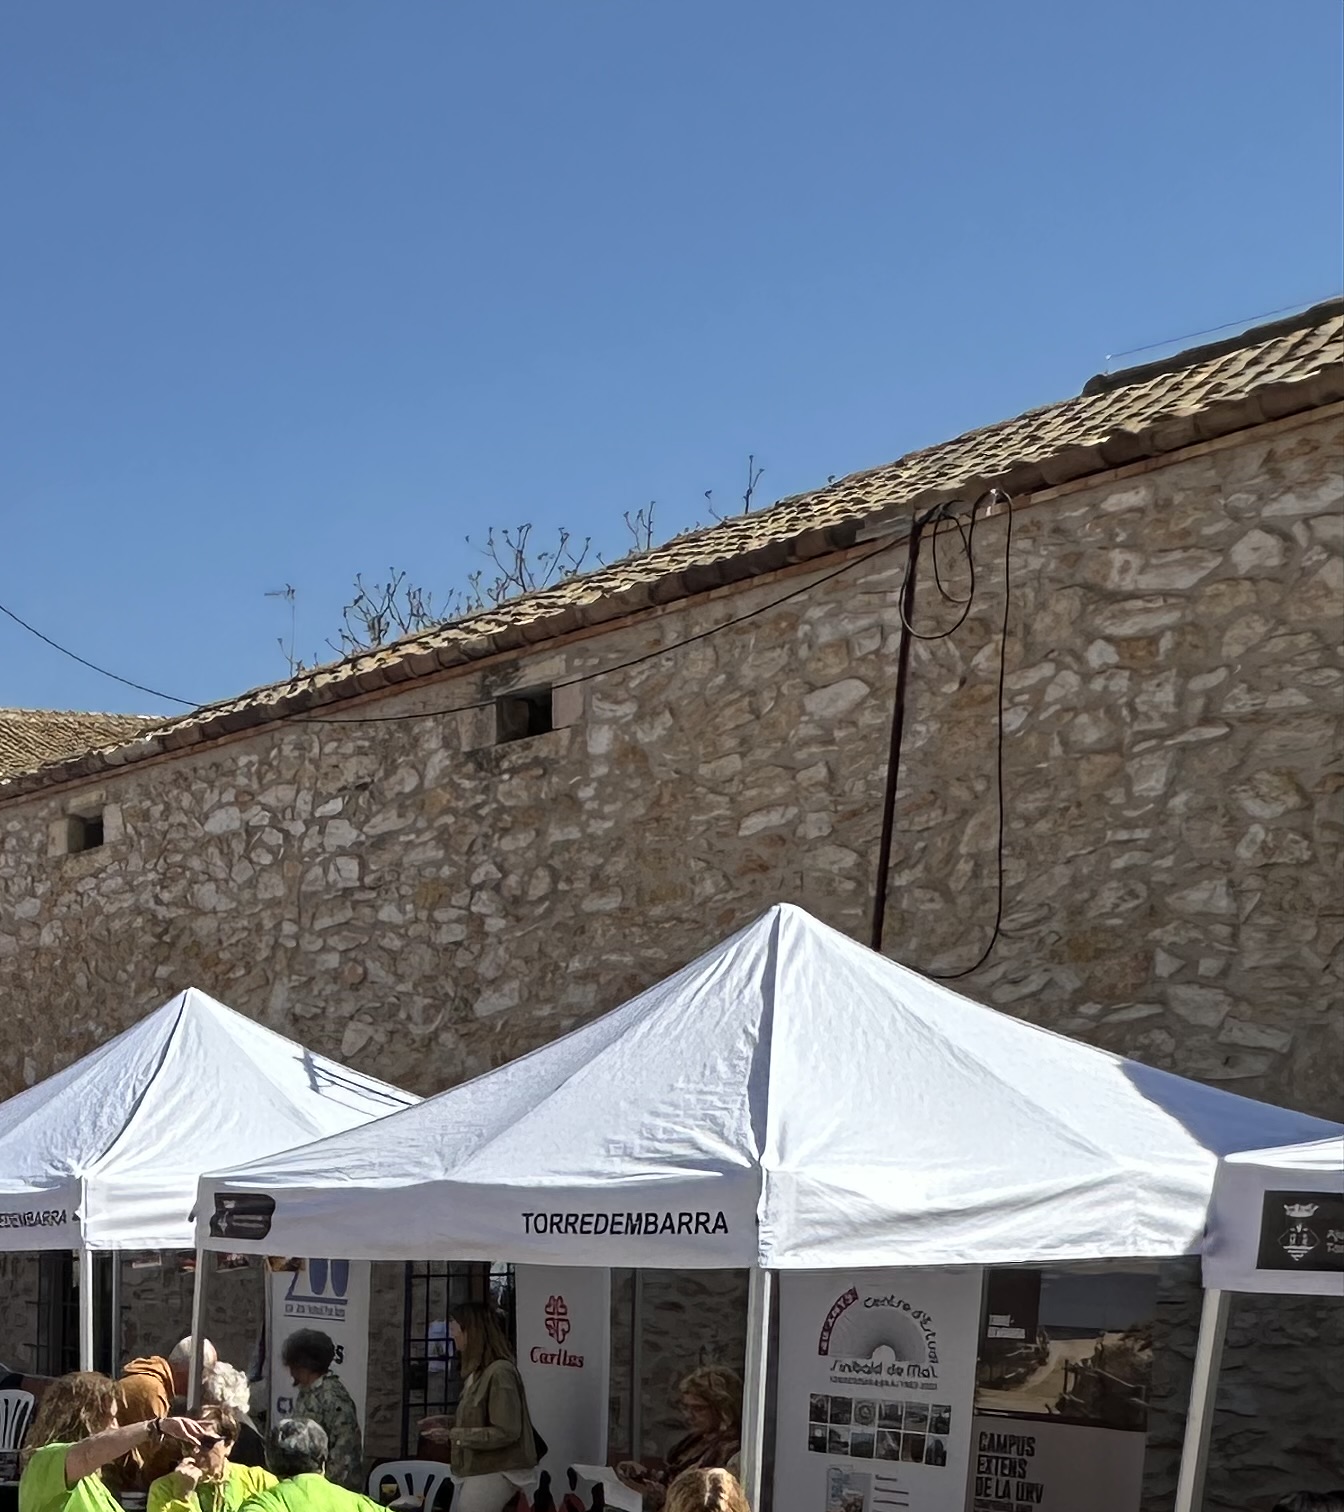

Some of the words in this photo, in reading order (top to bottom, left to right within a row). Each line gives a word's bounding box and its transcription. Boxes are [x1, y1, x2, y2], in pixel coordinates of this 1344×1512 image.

[521, 1211, 729, 1236] TORREDEMBARRA
[979, 1431, 1036, 1457] CAMPUS
[977, 1454, 1028, 1479] EXTENS
[975, 1476, 992, 1498] DE
[995, 1478, 1011, 1500] LA
